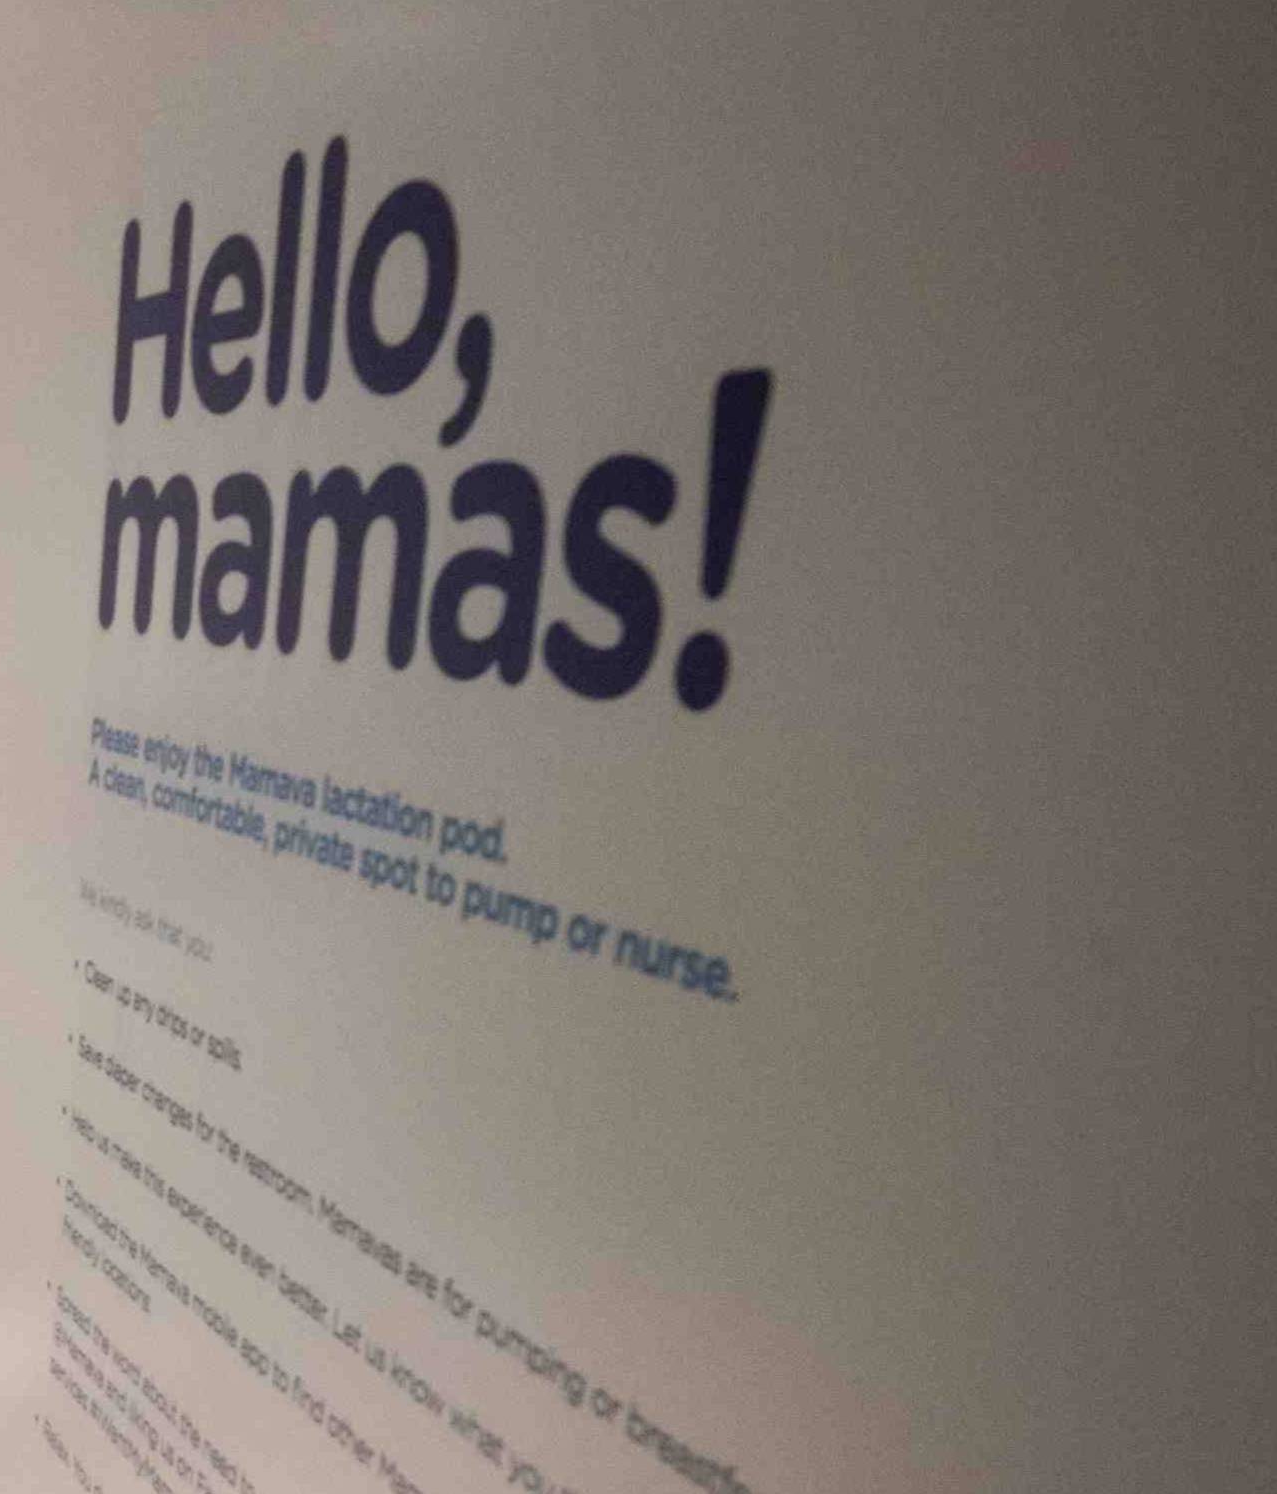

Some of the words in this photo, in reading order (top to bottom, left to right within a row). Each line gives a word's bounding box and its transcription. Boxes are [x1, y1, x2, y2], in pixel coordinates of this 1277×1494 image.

[113, 134, 494, 447] Hello,
[98, 367, 774, 712] mamas!
[89, 757, 100, 789] A
[102, 763, 148, 809] clean,
[151, 782, 270, 850] comfortable,
[272, 818, 355, 873] private
[358, 845, 421, 896] spot
[424, 861, 457, 908] to
[461, 880, 559, 946] pump
[566, 913, 609, 956] or
[613, 928, 740, 1004] nurse.
[91, 716, 140, 759] Please
[143, 734, 191, 779] enjoy
[193, 743, 224, 783] the
[228, 752, 317, 809] Mamava
[321, 773, 433, 843] lactation
[439, 815, 508, 864] pod.
[405, 1259, 440, 1302] are
[442, 1274, 474, 1321] for
[475, 1308, 588, 1409] pumping
[589, 1385, 624, 1424] or
